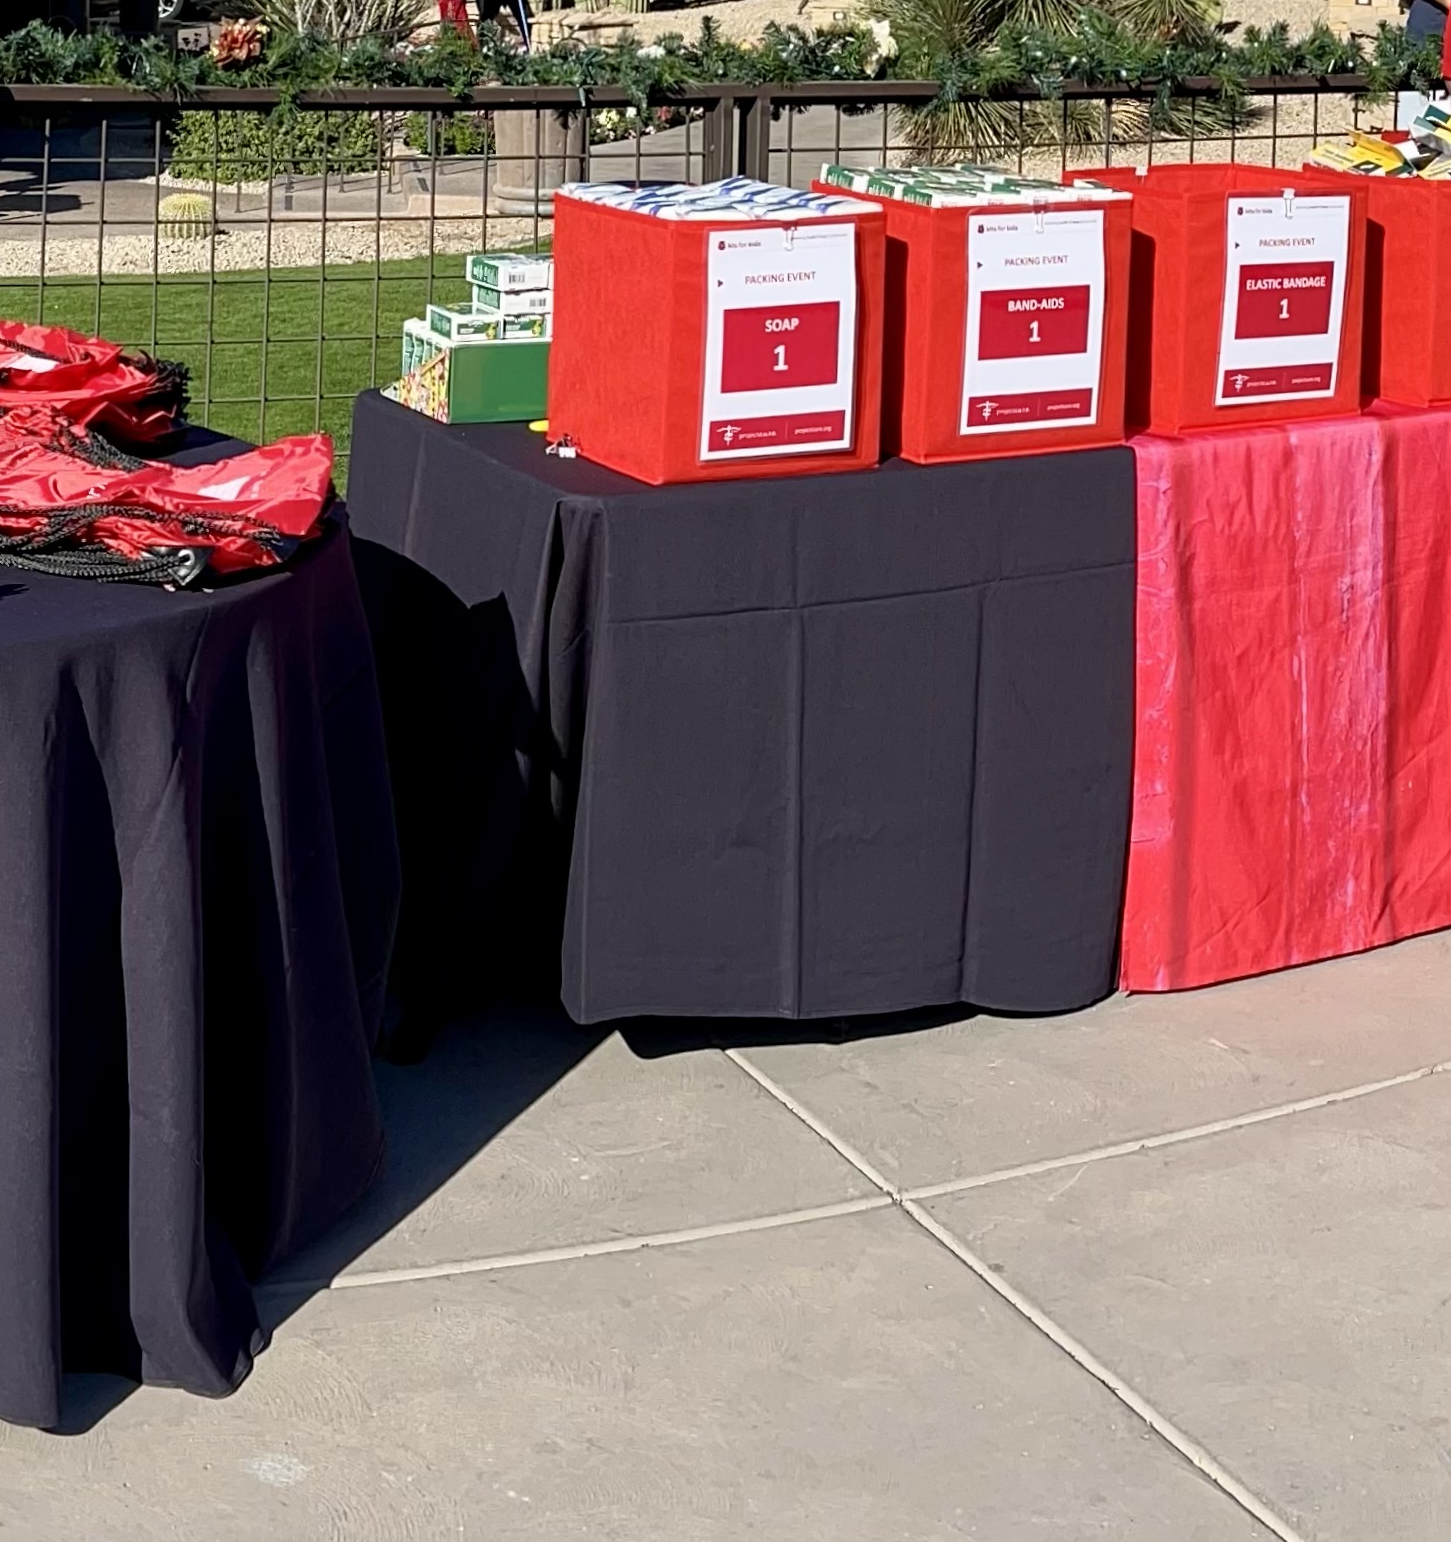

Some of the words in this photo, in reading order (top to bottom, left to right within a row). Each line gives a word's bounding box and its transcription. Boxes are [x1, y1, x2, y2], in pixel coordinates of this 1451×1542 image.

[1258, 238, 1291, 248] PACKING
[1292, 237, 1316, 246] EVENT
[1004, 256, 1041, 267] PACKING
[1042, 254, 1069, 265] EVENT
[744, 273, 785, 285] PACKING
[787, 271, 816, 282] EVENT
[1246, 277, 1282, 291] ELASTIC
[1283, 275, 1327, 290] BANDAGE
[1007, 297, 1065, 312] BAND-AIDS
[1278, 298, 1290, 319] 1
[764, 317, 800, 333] SOAP
[1028, 319, 1041, 343] 1
[772, 344, 789, 372] 1
